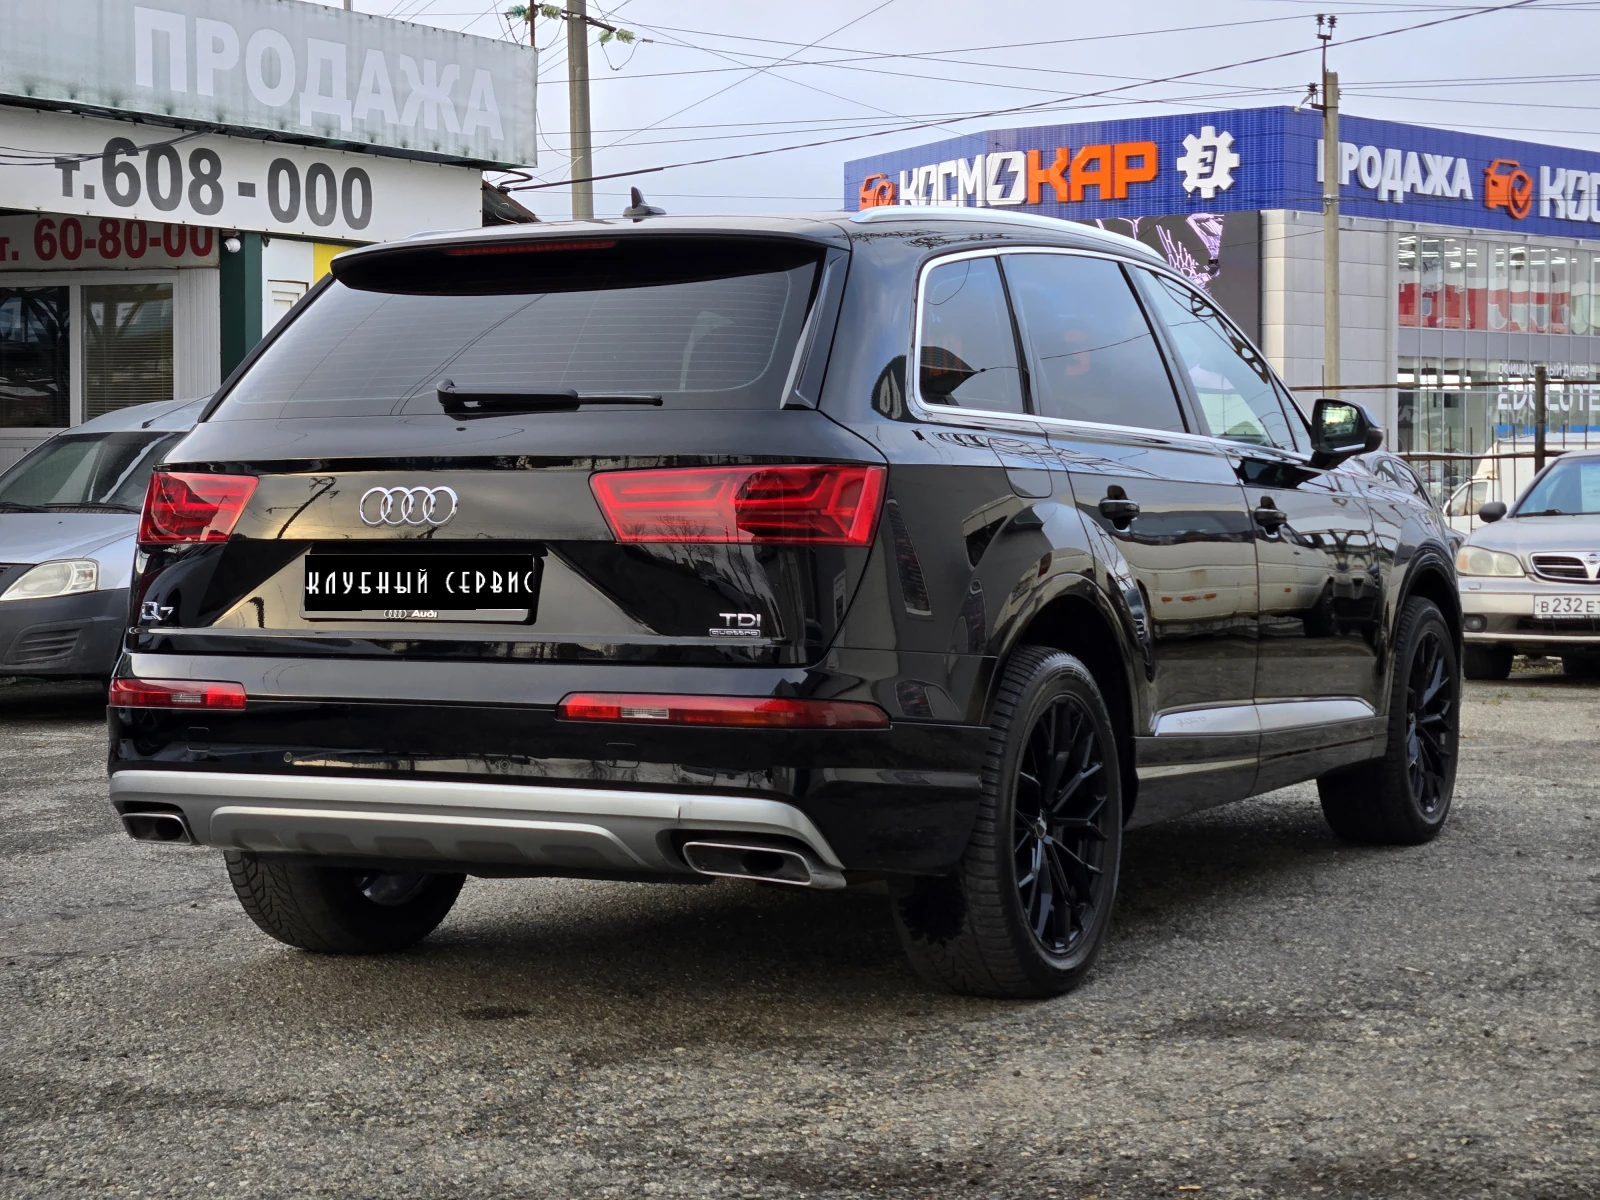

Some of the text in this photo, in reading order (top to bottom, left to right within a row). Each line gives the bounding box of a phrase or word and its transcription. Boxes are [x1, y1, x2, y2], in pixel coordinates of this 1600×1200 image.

[133, 5, 505, 142] ПРОДАЖА
[34, 217, 213, 261] 60-80-00
[1563, 365, 1589, 378] ДИЛЕР
[141, 601, 174, 620] Q7
[411, 609, 438, 618] Audi
[719, 613, 761, 627] TDI
[710, 629, 759, 637] quattro
